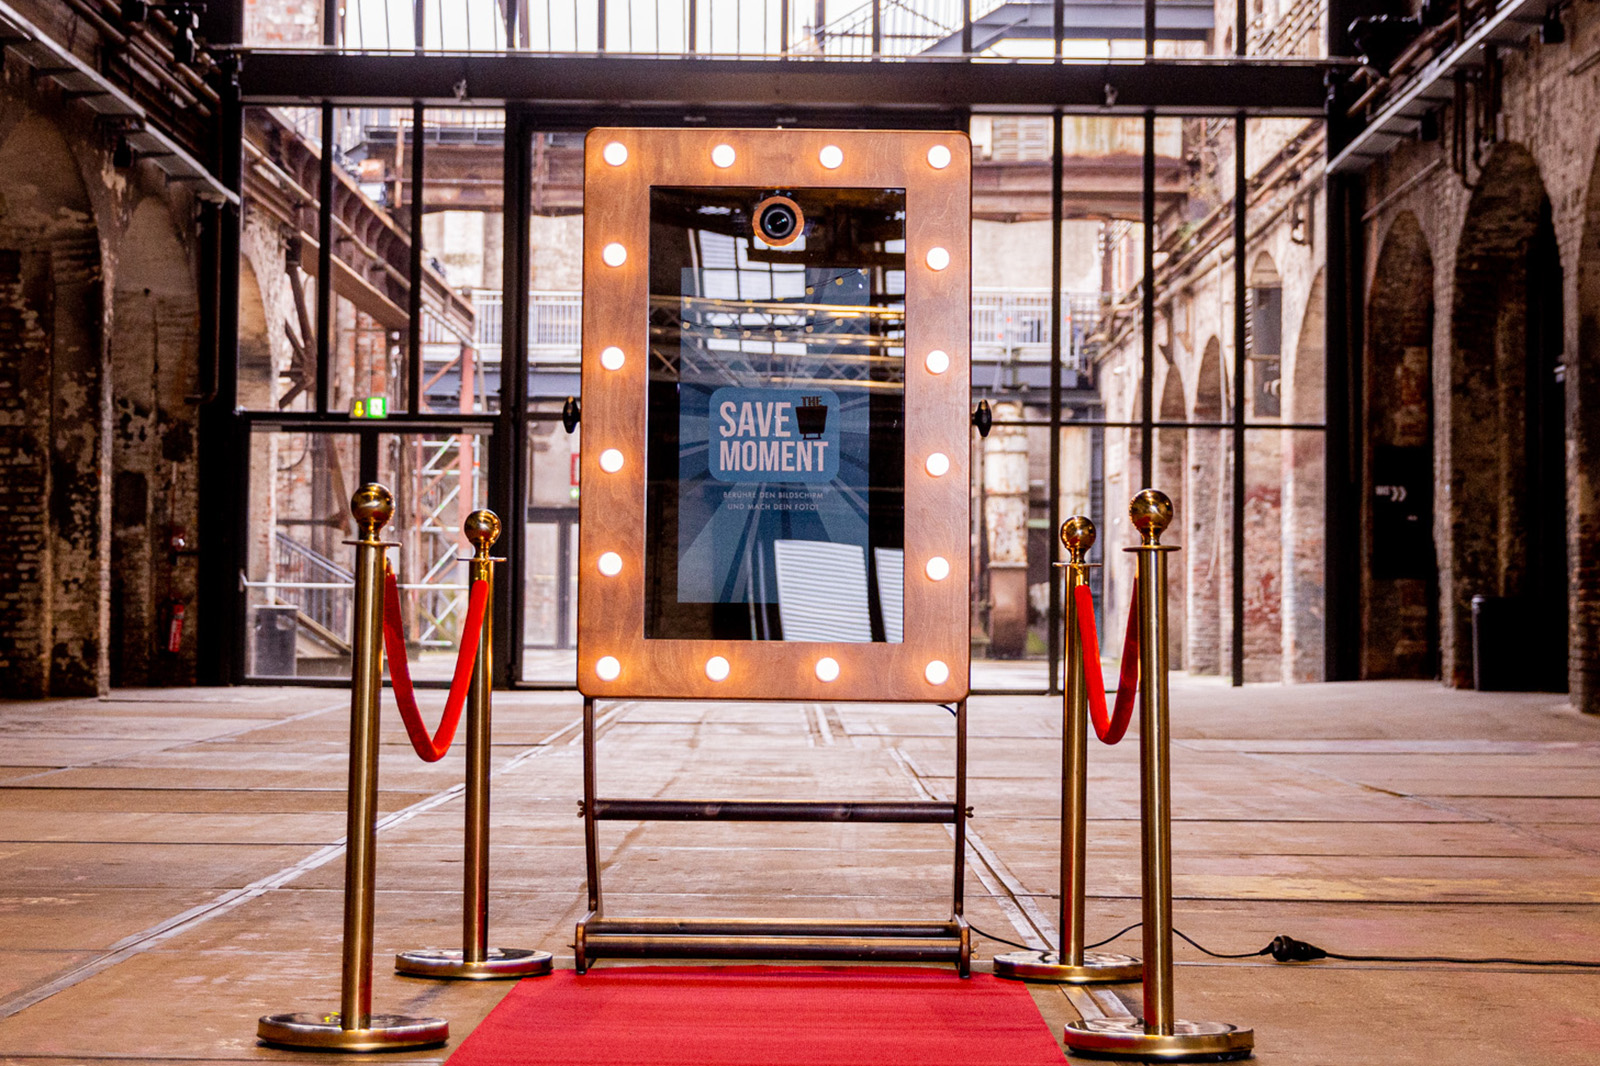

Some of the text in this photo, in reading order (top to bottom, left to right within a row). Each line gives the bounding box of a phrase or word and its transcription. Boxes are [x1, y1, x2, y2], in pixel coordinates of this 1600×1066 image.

[801, 396, 822, 407] THE
[719, 401, 791, 437] SAVE
[719, 441, 829, 472] MOMENT
